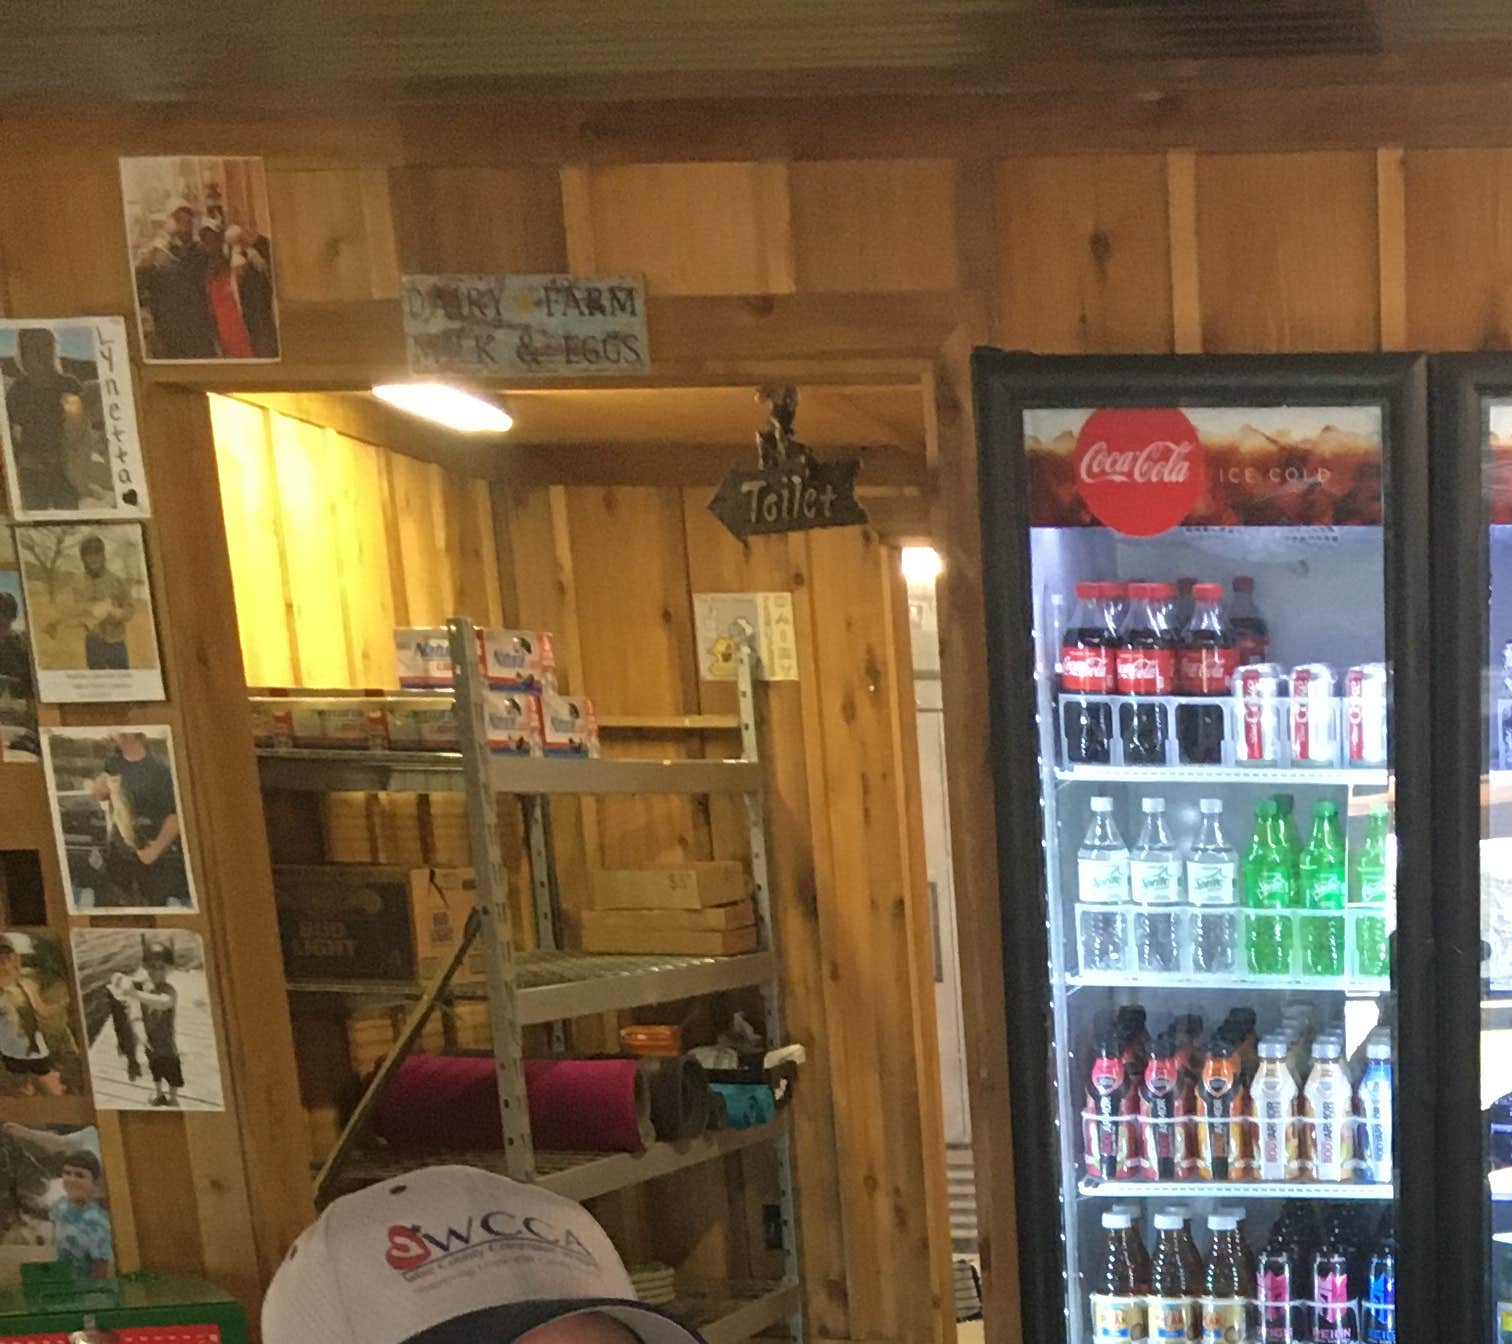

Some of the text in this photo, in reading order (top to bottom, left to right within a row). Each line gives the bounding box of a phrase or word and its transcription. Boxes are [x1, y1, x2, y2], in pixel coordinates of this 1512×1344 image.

[543, 286, 638, 317] FARM
[516, 331, 541, 365] &
[563, 331, 642, 365] EGGS
[1080, 441, 1332, 484] Coca-Cola ICE COLD
[741, 475, 839, 523] Toilet
[1367, 1328, 1396, 1340] REIG
